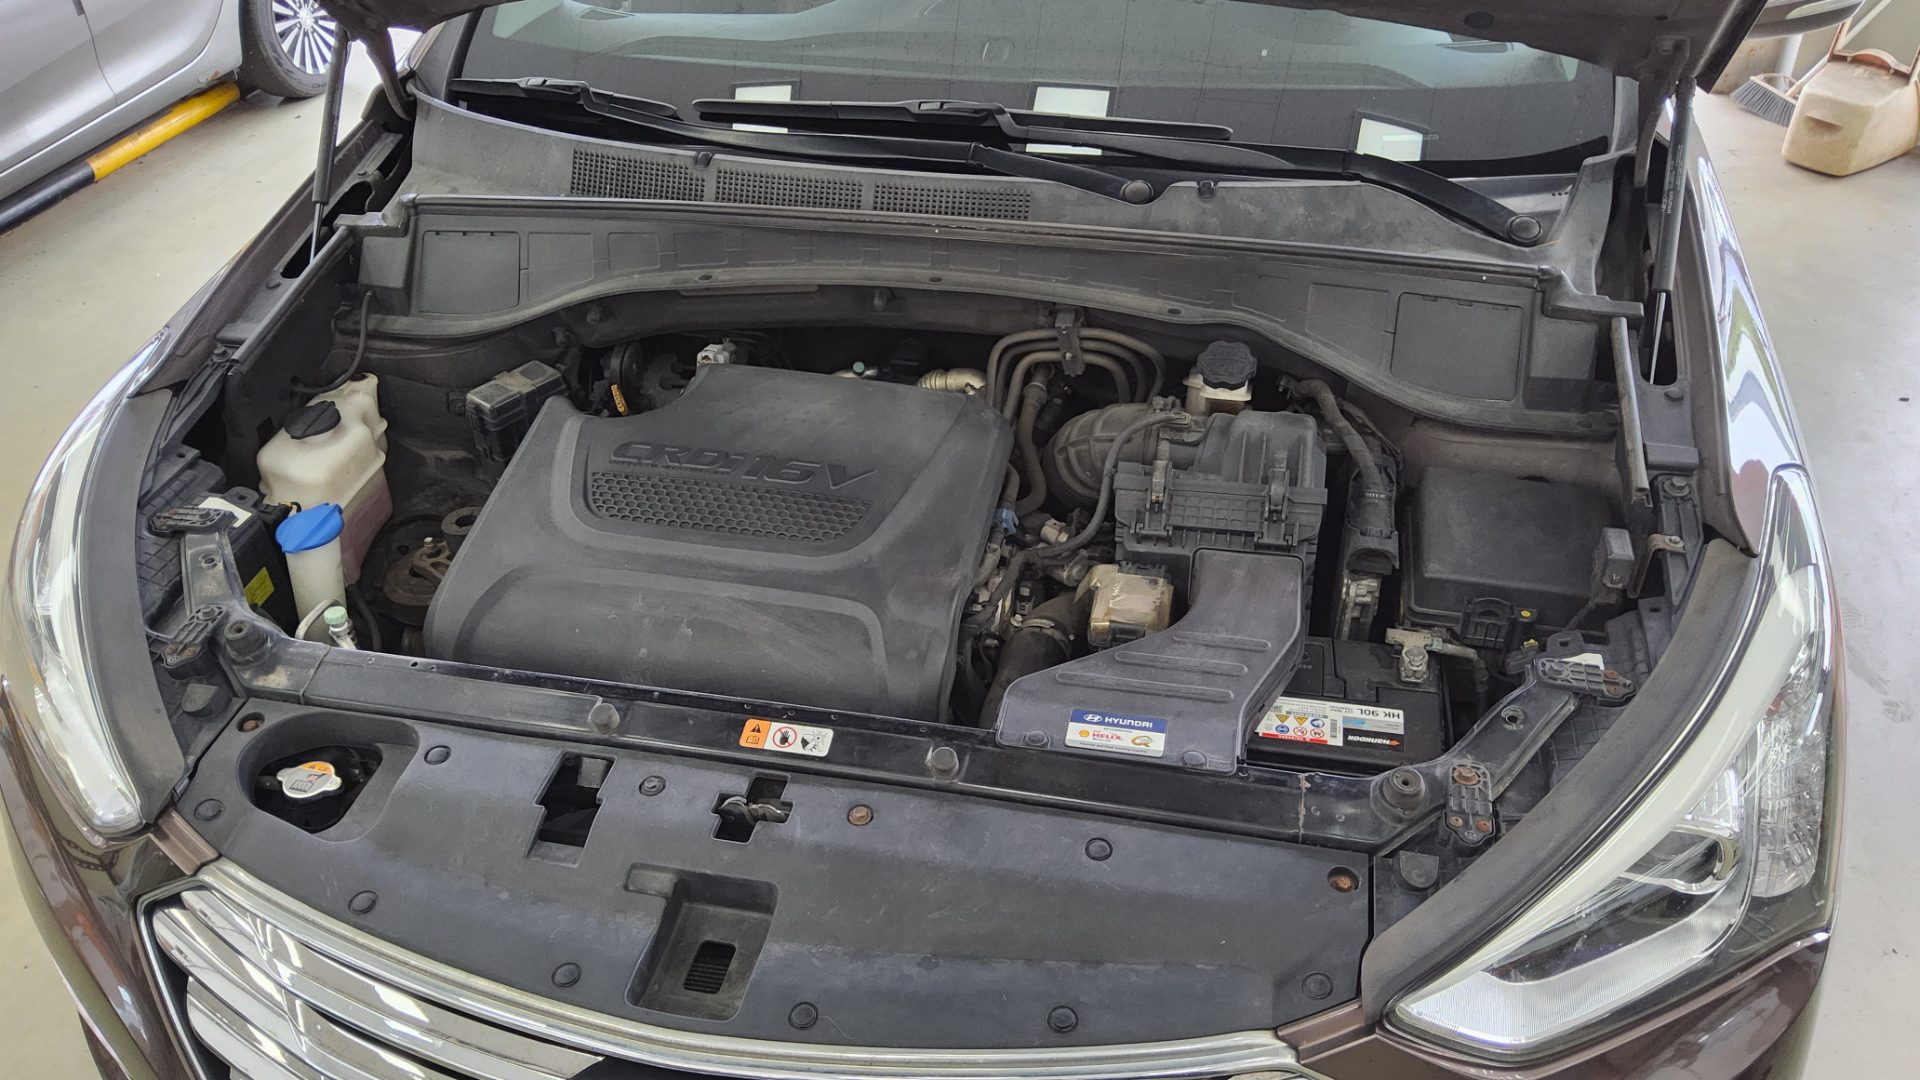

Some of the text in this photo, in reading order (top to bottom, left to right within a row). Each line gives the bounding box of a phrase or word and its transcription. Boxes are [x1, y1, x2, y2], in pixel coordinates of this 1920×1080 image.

[1356, 708, 1379, 717] 90L
[1383, 711, 1401, 719] HK
[1105, 716, 1153, 728] HYUNDAI
[1092, 732, 1121, 741] HELIX
[1347, 735, 1391, 744] HANKOOK
